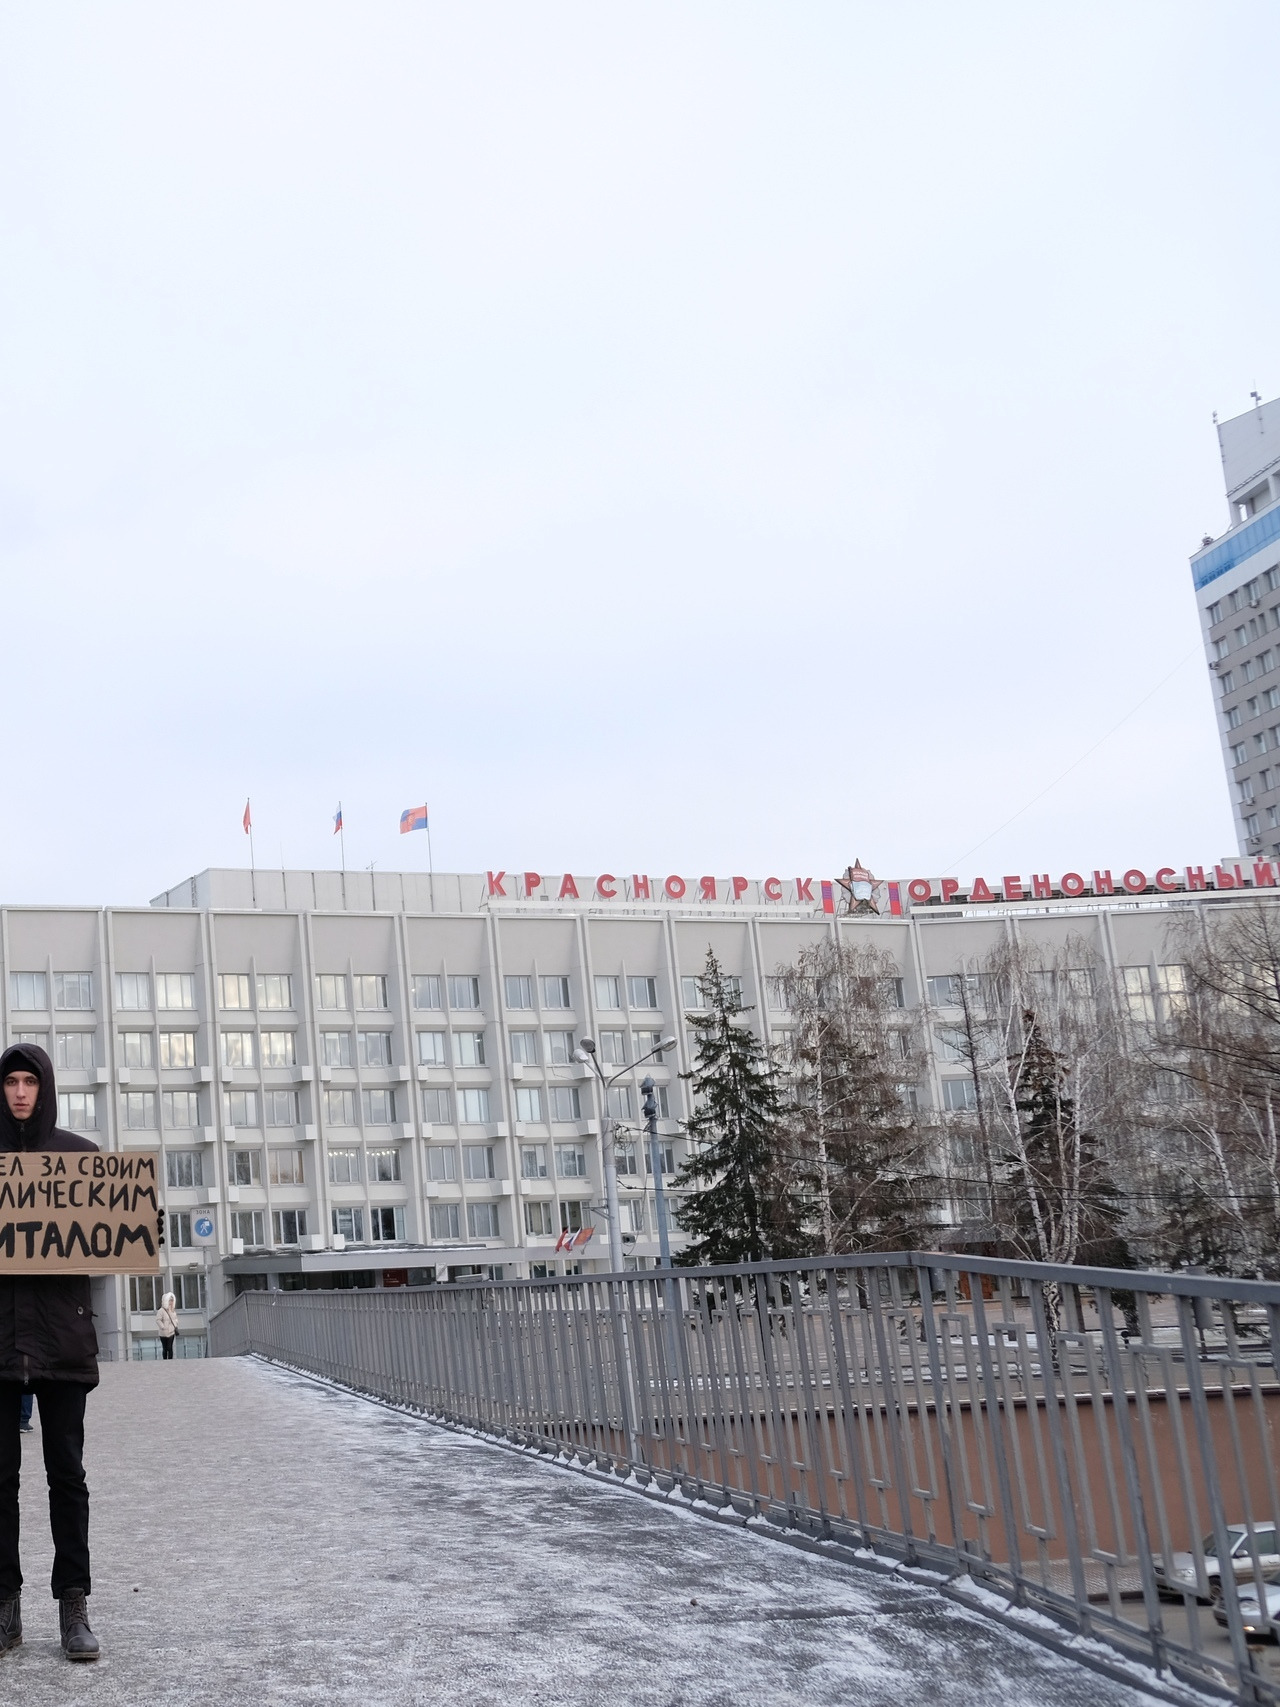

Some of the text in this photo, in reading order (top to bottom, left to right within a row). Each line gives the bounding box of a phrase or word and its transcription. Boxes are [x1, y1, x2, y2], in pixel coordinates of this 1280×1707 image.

[484, 871, 815, 902] КРАСНОЯРСК
[41, 1155, 67, 1177] ЗА
[78, 1155, 155, 1180] СВОИМ
